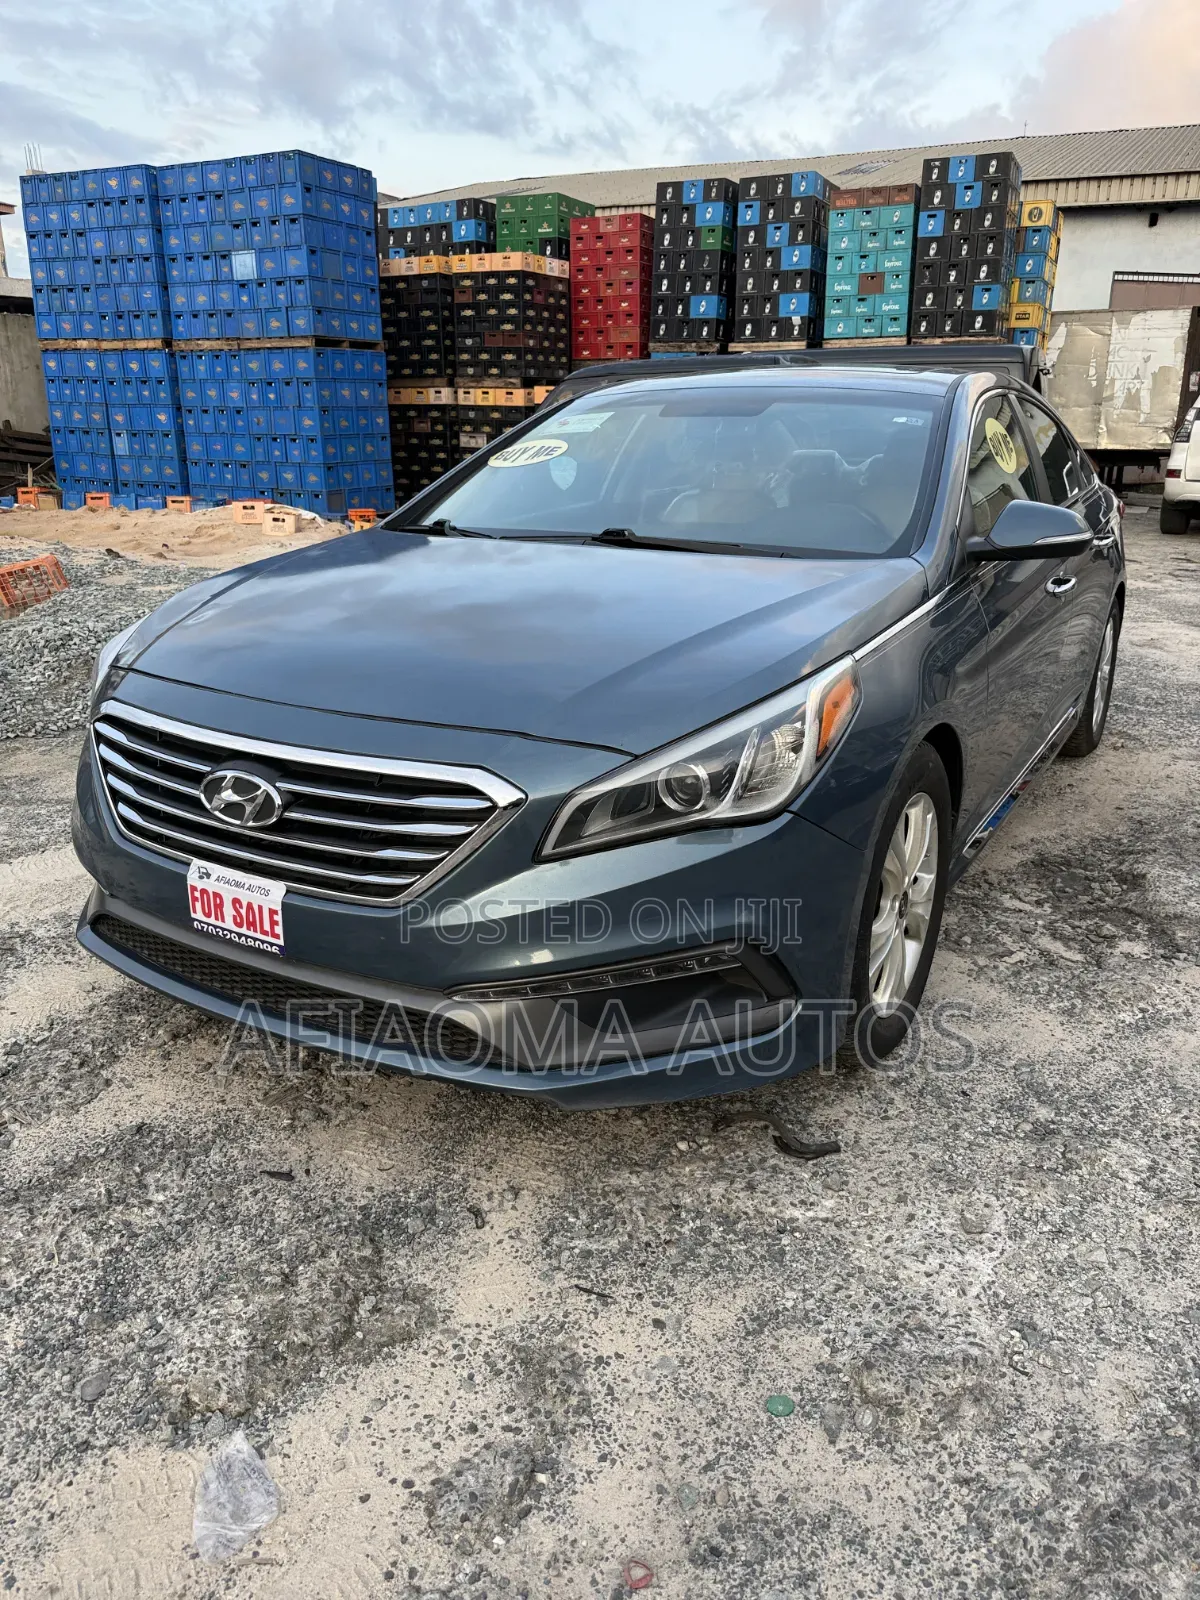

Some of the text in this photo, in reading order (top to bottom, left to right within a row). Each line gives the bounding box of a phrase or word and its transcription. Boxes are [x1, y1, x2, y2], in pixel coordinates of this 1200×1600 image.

[494, 445, 562, 463] BUY ME
[213, 874, 271, 898] AFIAOMA AUTOS
[189, 884, 281, 941] FOR SALE
